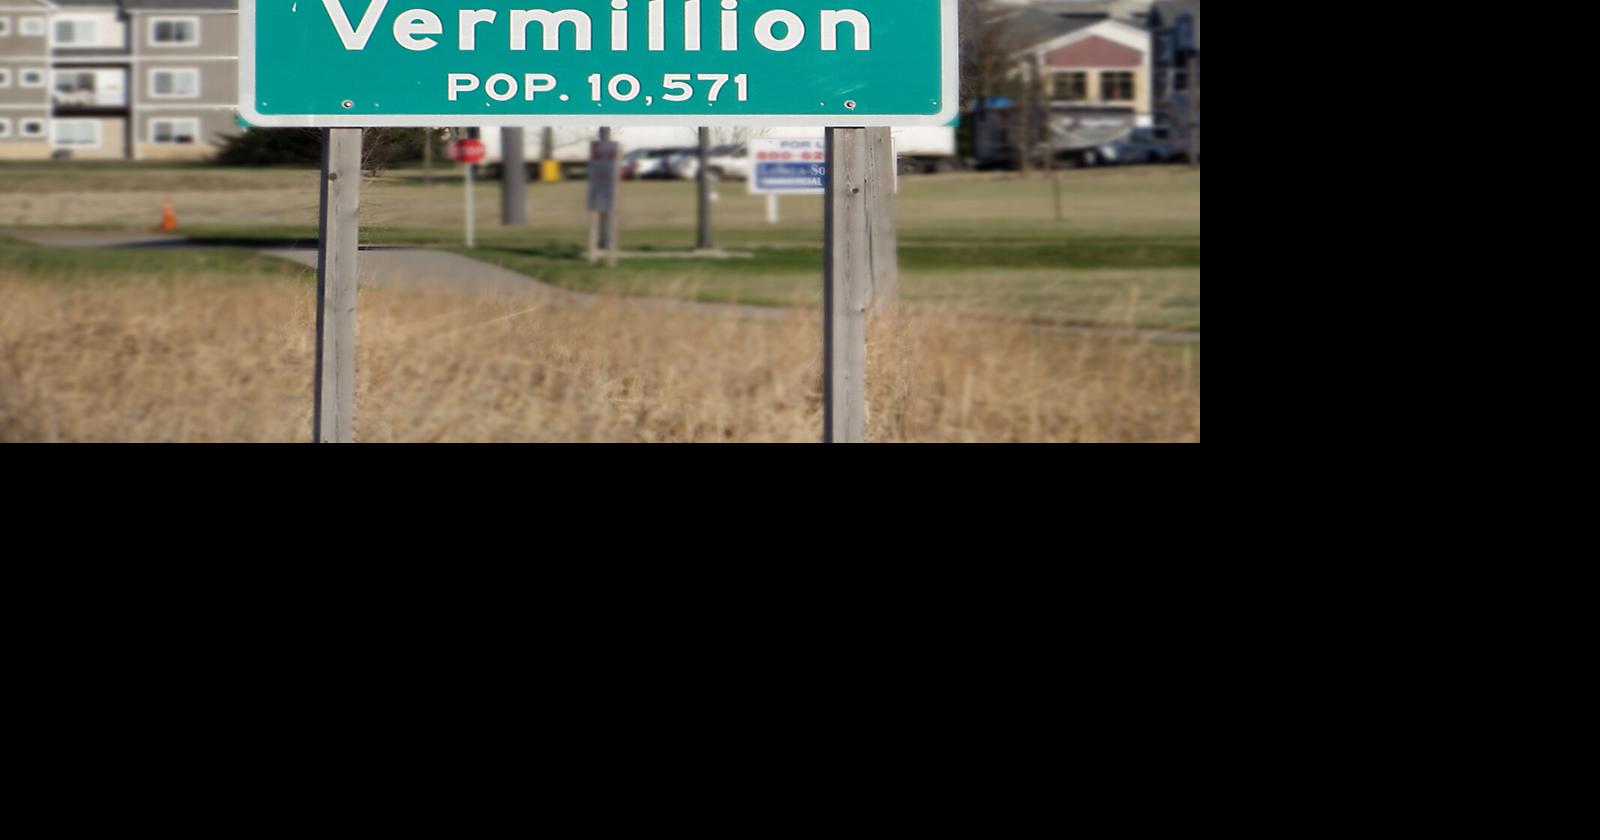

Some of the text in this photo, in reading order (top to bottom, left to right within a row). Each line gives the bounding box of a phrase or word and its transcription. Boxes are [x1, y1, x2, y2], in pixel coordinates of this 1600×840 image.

[322, 0, 871, 52] Vermillion
[446, 72, 749, 106] POP. 10,571
